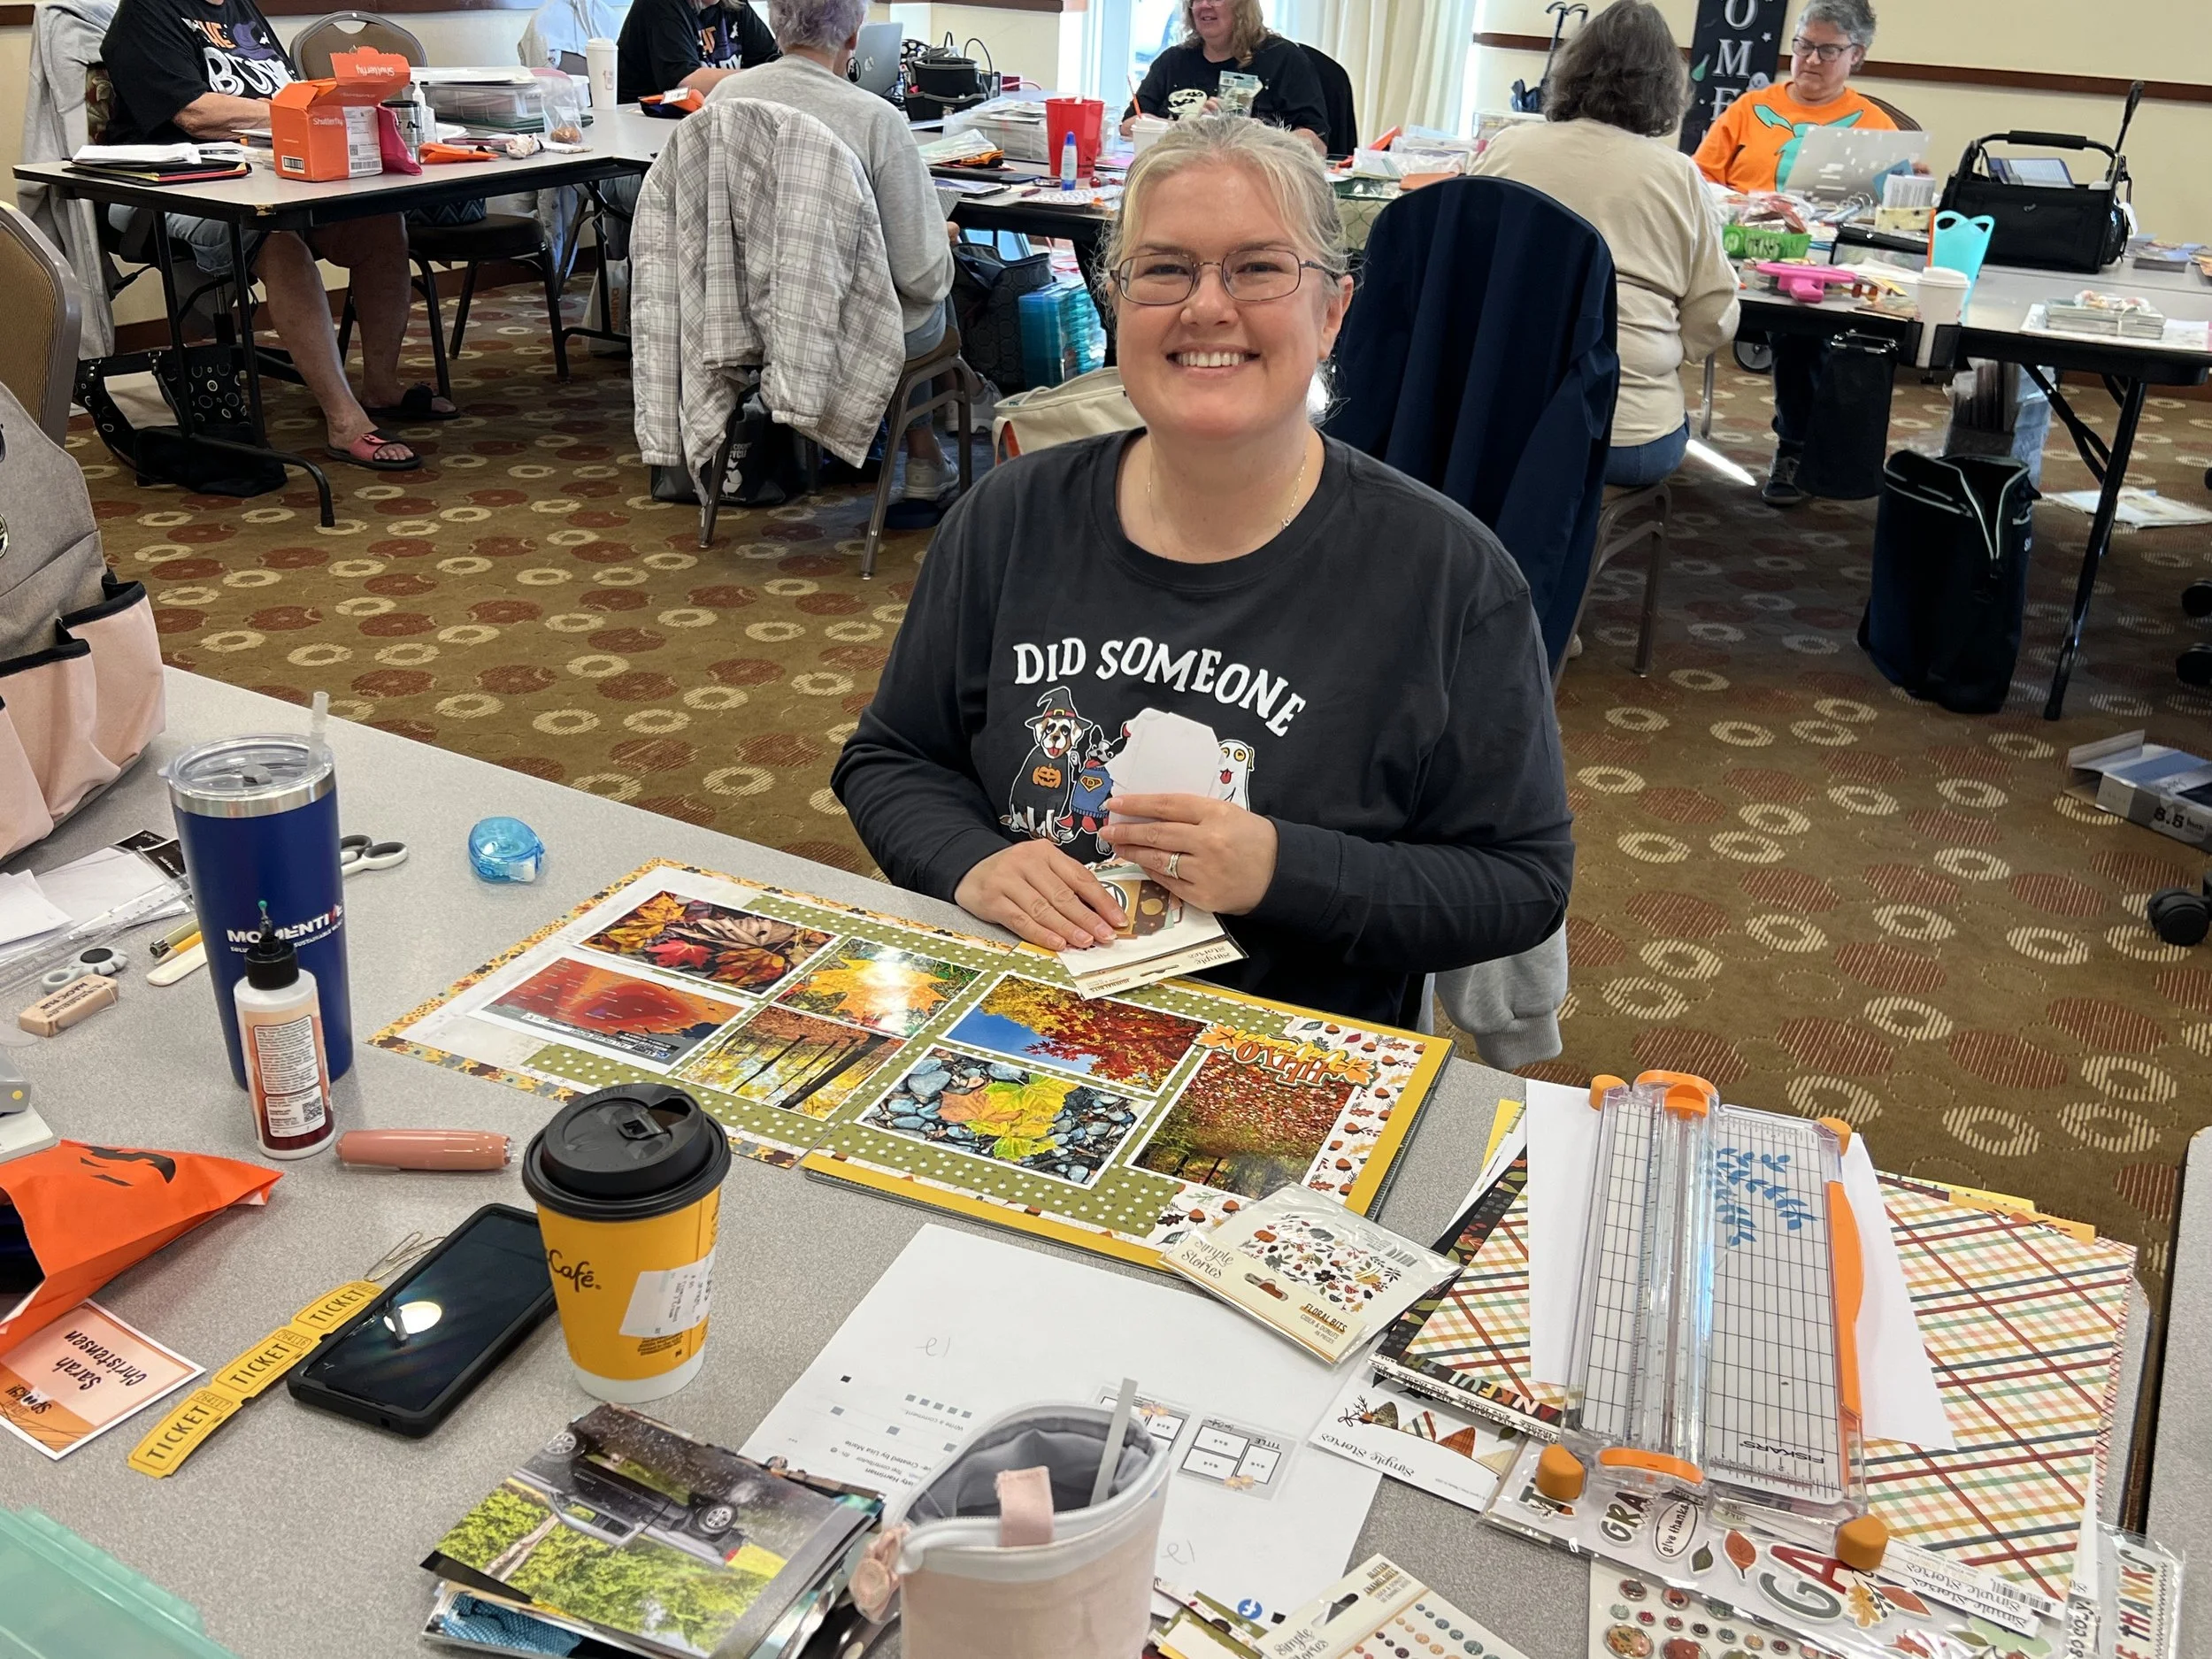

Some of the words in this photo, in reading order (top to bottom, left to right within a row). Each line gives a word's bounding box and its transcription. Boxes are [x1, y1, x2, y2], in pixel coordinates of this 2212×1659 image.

[356, 64, 395, 76] Shutterfly
[312, 117, 343, 127] Shutterfly
[1013, 637, 1087, 685] DID
[1096, 637, 1306, 737] SOMEONE
[1181, 1248, 1223, 1279] Stories
[310, 1289, 366, 1323] TICKET
[1303, 1303, 1331, 1324] FLORAL
[1329, 1317, 1348, 1333] BITS
[277, 1329, 310, 1347] 264116
[64, 1330, 148, 1386] Christensen
[230, 1343, 290, 1386] TICKET
[51, 1356, 101, 1391] Sarah
[196, 1390, 231, 1409] 264117
[147, 1405, 211, 1460] TICKET
[1256, 1438, 1281, 1450] TITLE
[1321, 1432, 1367, 1457] Stories
[844, 1440, 865, 1453] Marie
[864, 1446, 879, 1456] Lisa
[1742, 1440, 1825, 1464] FISKARS
[864, 1467, 900, 1484] Harriman
[888, 1455, 918, 1471] Created
[1370, 1451, 1415, 1478] Simple
[1662, 1532, 1677, 1555] give
[1905, 1562, 1962, 1590] Stories
[1274, 1627, 1314, 1655] Simple
